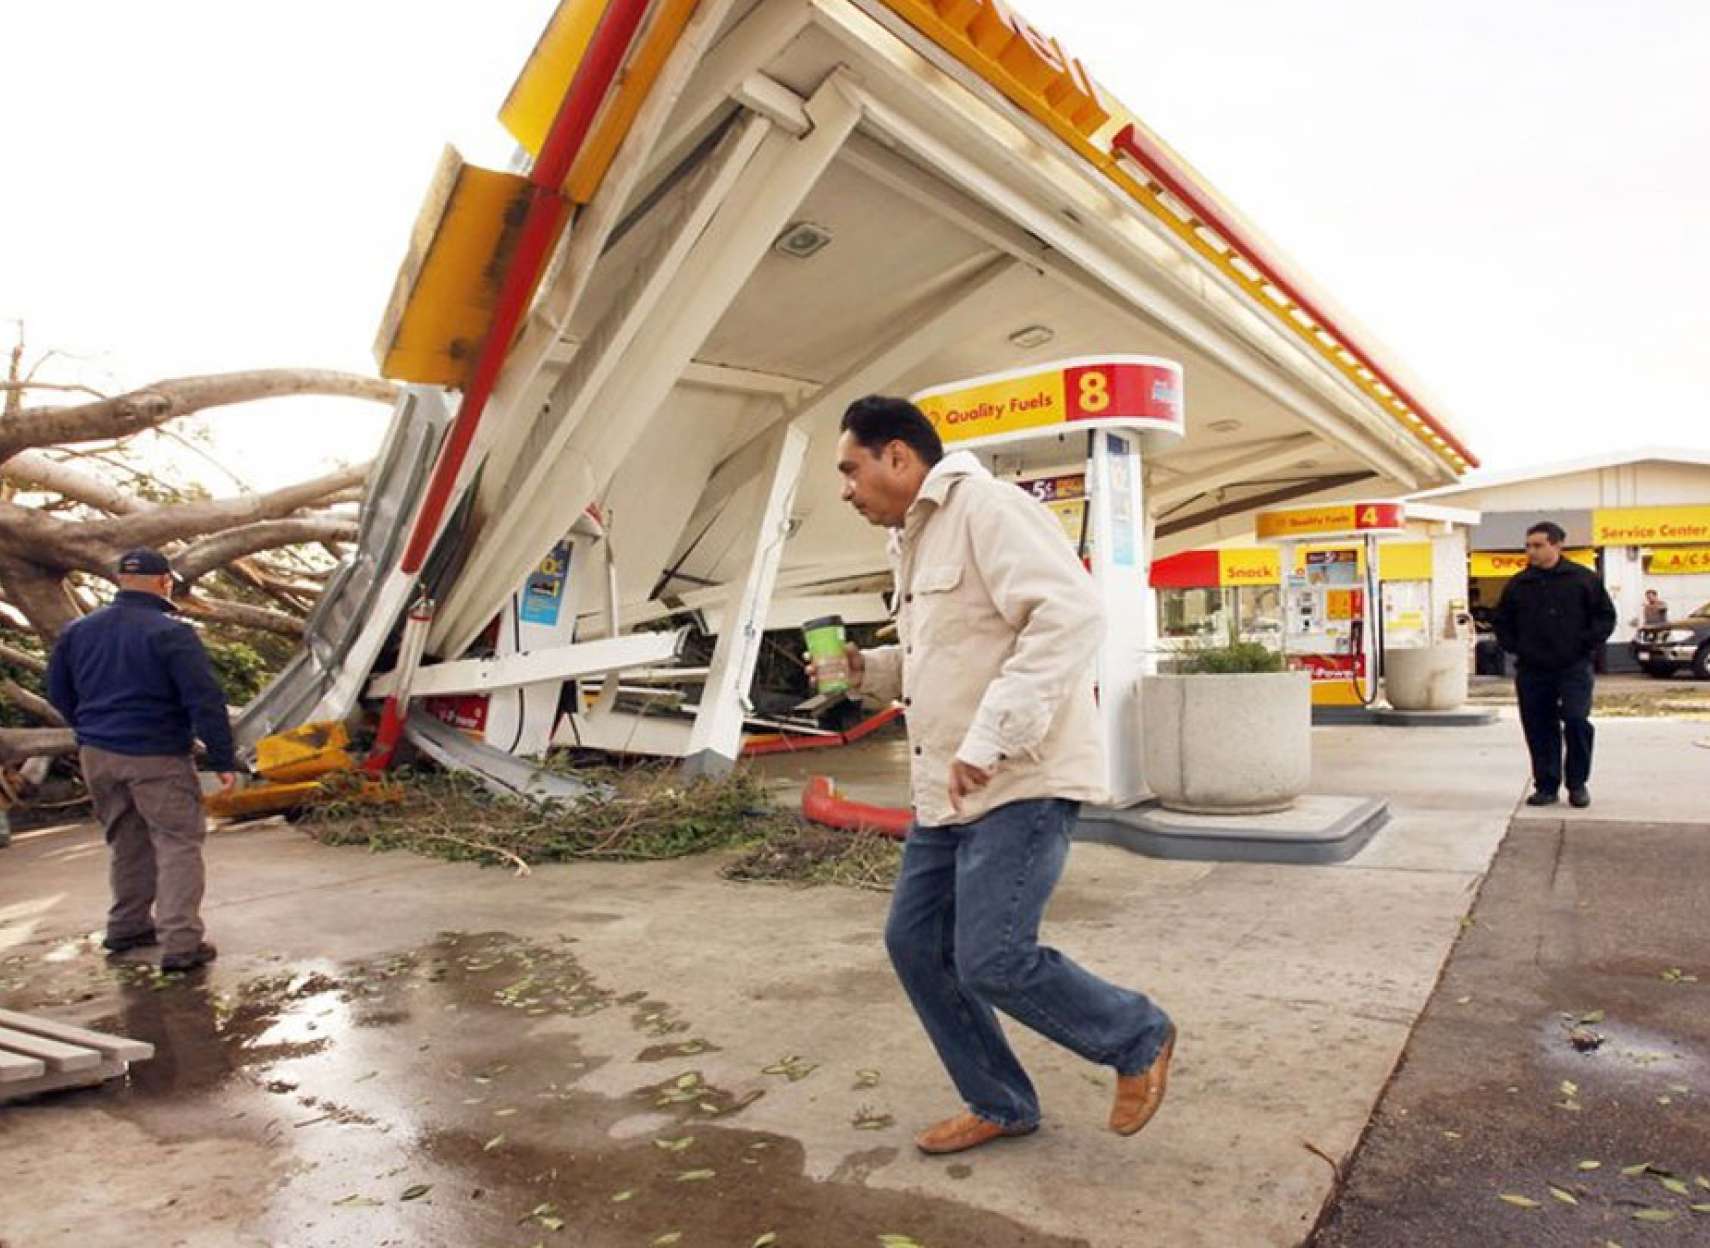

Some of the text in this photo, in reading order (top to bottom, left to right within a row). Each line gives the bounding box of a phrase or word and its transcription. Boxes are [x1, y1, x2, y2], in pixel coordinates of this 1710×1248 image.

[945, 371, 1110, 425] Quality Fuels 8
[1361, 505, 1378, 526] 4
[1601, 524, 1708, 539] Service Center
[1670, 552, 1698, 567] A/C
[1226, 565, 1272, 578] Snack
